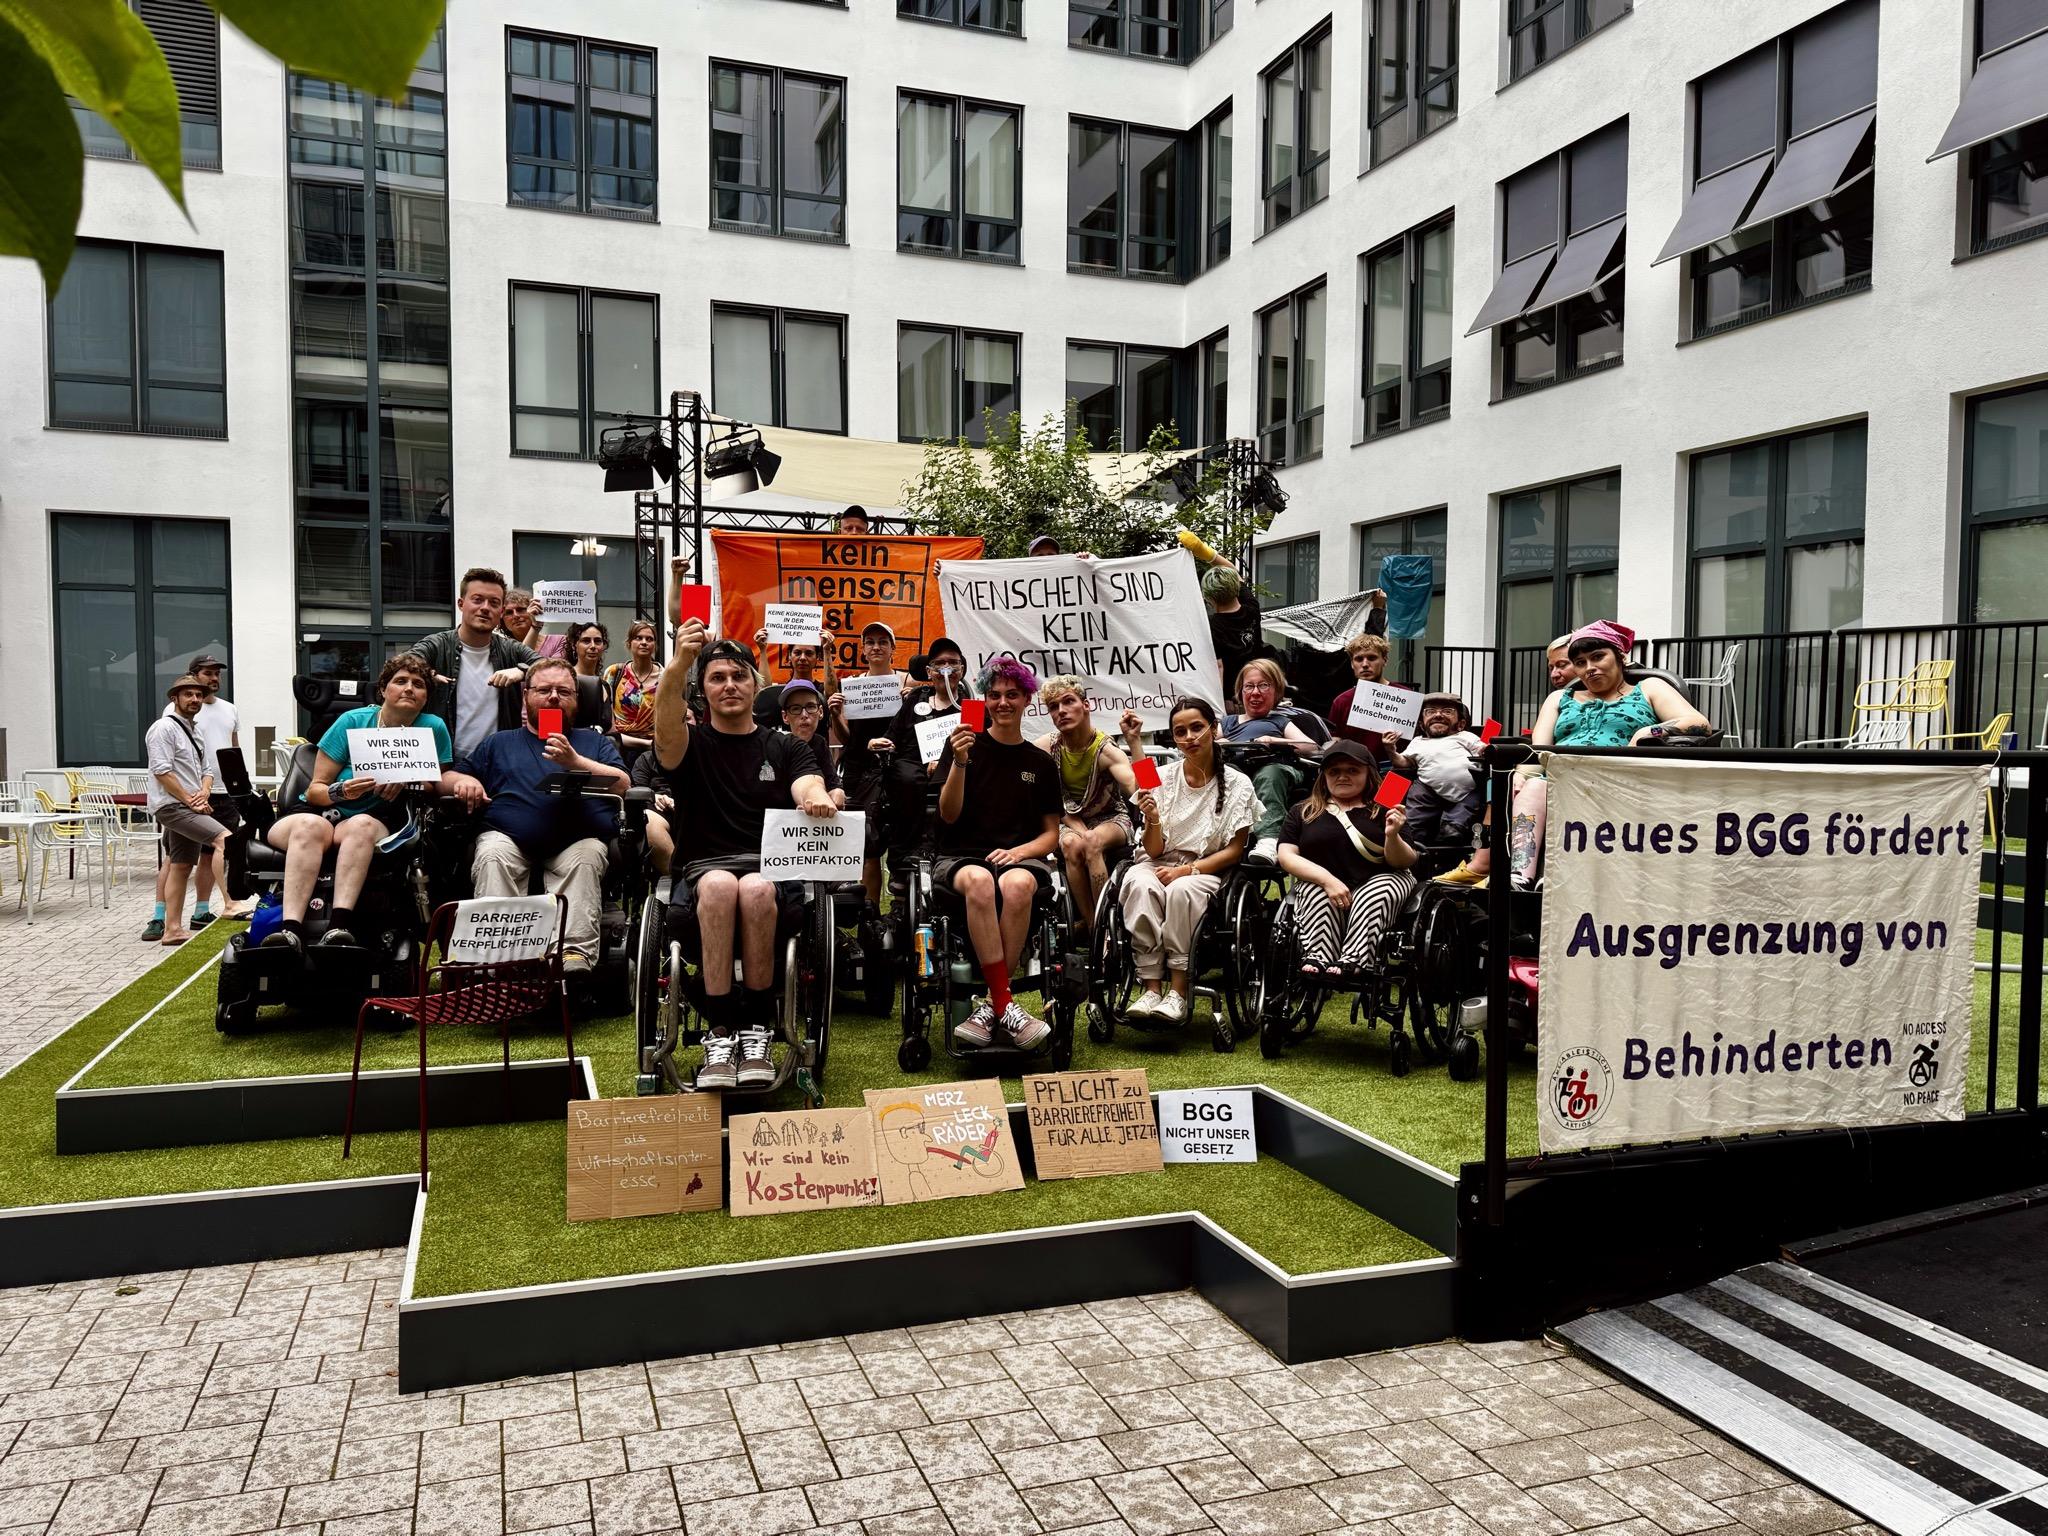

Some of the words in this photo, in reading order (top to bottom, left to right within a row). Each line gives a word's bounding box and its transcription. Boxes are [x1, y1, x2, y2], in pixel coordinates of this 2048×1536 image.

[822, 540, 889, 567] kein
[788, 572, 916, 601] mensch
[950, 574, 1099, 611] MENSCHEN
[1110, 571, 1164, 603] SIND
[546, 598, 583, 606] FREIHEIT
[543, 606, 594, 614] RPFLICHTEND!
[786, 610, 821, 618] KÜRZUNGEN
[825, 602, 854, 631] st
[1042, 610, 1109, 643] KEIN
[1371, 688, 1407, 704] Teilhabe
[1372, 699, 1384, 709] ist
[1385, 704, 1399, 712] ein
[1352, 704, 1416, 728] Menschenrecht
[937, 719, 957, 729] KEIN
[367, 739, 390, 748] WIR
[393, 738, 420, 748] SIND
[381, 750, 409, 759] KEIN
[354, 761, 437, 772] KOSTENFAKTOR
[782, 827, 809, 838] WIR
[812, 826, 844, 837] SIND
[1562, 819, 1699, 855] neues
[1714, 811, 1810, 857] BGG
[1824, 811, 1970, 857] fördert
[797, 841, 829, 852] KEIN
[764, 855, 861, 867] KOSTENFAKTOR
[470, 911, 543, 923] BARRIERE-
[474, 925, 534, 937] FREIHEIT
[452, 937, 548, 950] VERPFLICHTEND!
[1565, 912, 1864, 969] Ausgrenzung
[1875, 919, 1947, 953] von
[1902, 1023, 1914, 1036] NO
[1915, 1021, 1947, 1035] ACCESS
[1622, 1029, 1892, 1081] Behinderten
[1033, 1077, 1119, 1104] PFLICHT
[1903, 1092, 1915, 1105] NO
[1917, 1090, 1940, 1104] PEACE
[924, 1090, 967, 1107] MERZ
[575, 1106, 711, 1129] Barrierefreiheit
[953, 1105, 993, 1123] LECK
[1031, 1101, 1146, 1127] BARRIEREFREIHEIT
[1183, 1102, 1233, 1122] BGG
[624, 1133, 647, 1145] als
[932, 1121, 988, 1145] RÄDER
[1047, 1127, 1077, 1147] FÜR
[1115, 1124, 1157, 1145] JETZT!
[1166, 1127, 1204, 1138] NICHT
[1206, 1128, 1250, 1140] UNSER
[1183, 1143, 1234, 1155] GESETZ
[743, 1150, 774, 1167] Wir
[782, 1150, 813, 1165] sind
[619, 1175, 658, 1189] esse
[745, 1170, 878, 1205] Kostenpunkt!
